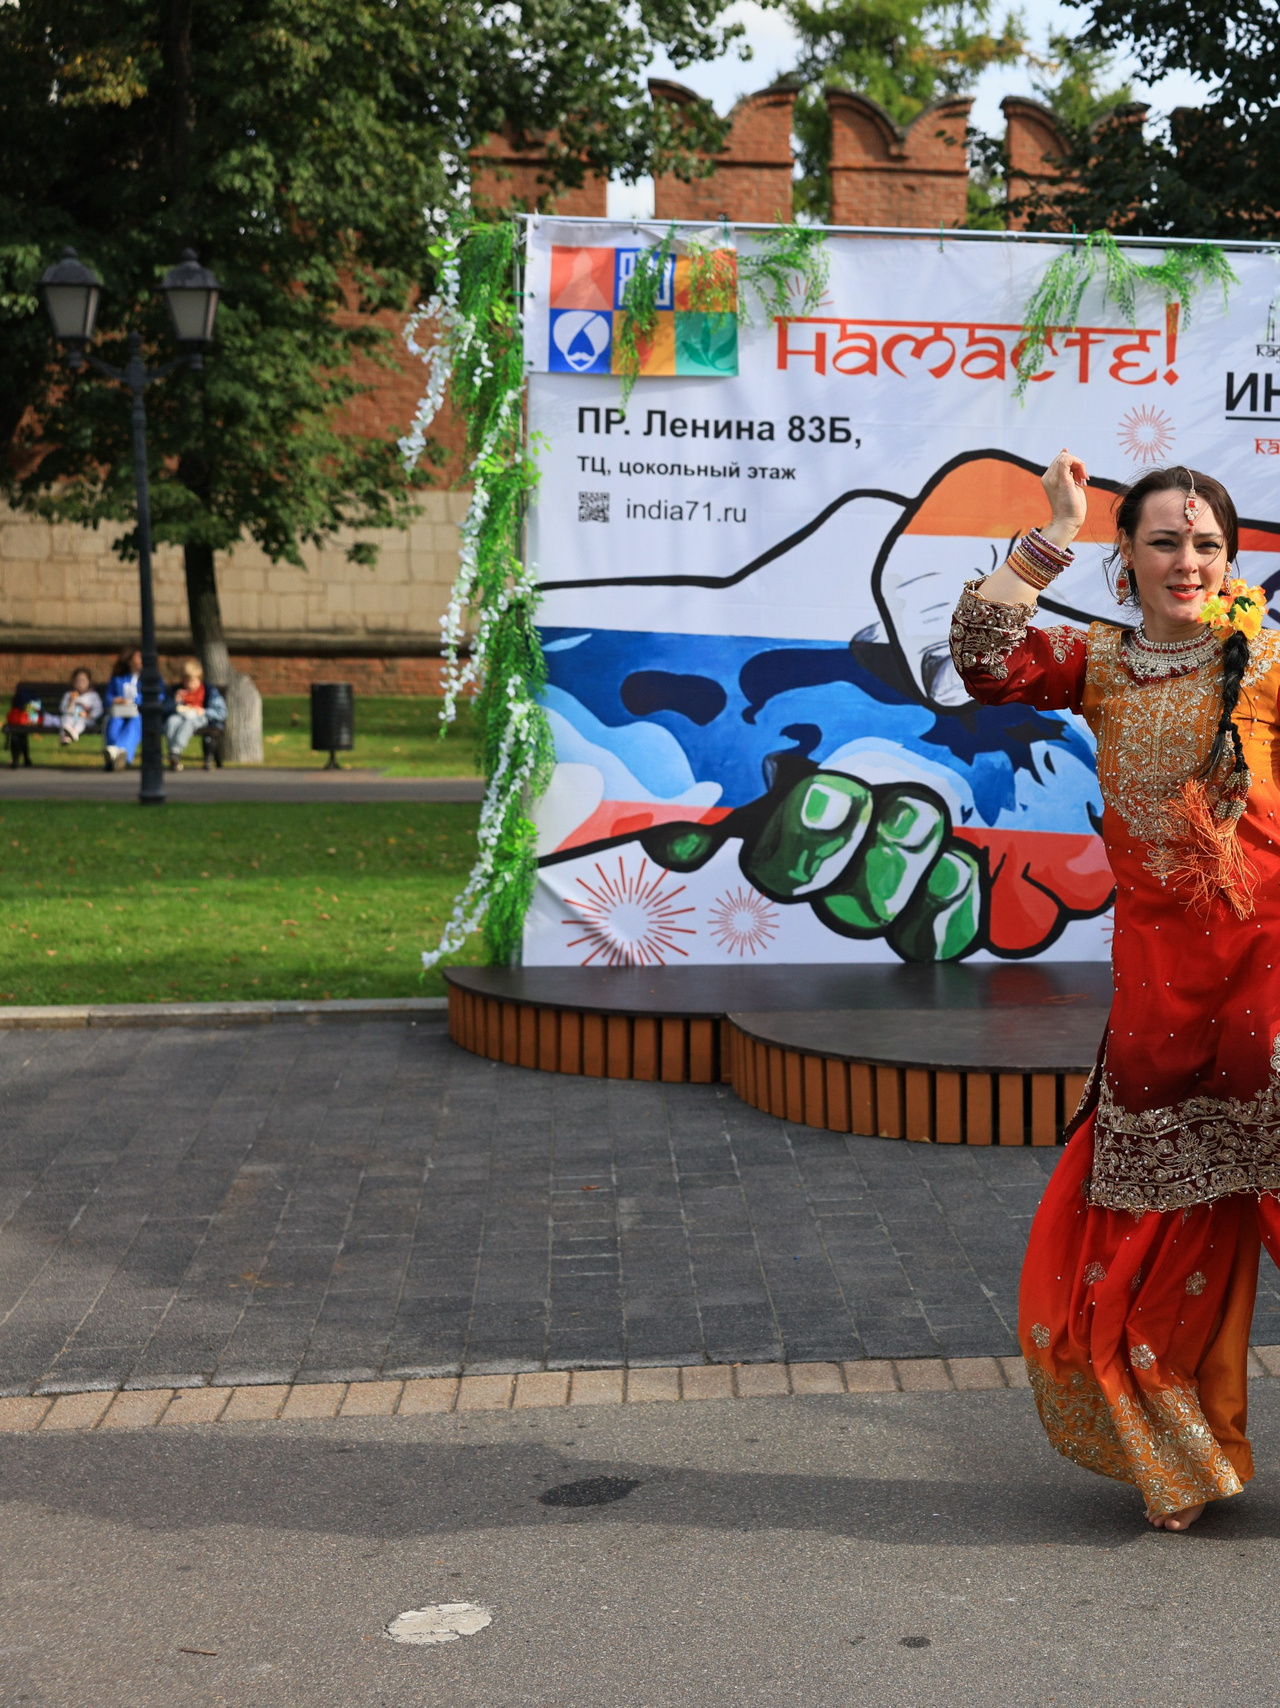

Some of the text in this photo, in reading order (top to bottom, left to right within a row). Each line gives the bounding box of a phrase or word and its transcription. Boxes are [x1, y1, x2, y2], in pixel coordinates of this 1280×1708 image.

[578, 407, 861, 449] ПР. Ленина 83Б,
[577, 456, 796, 480] ТЦ, цокольный этаж
[626, 499, 747, 523] india71.ru
